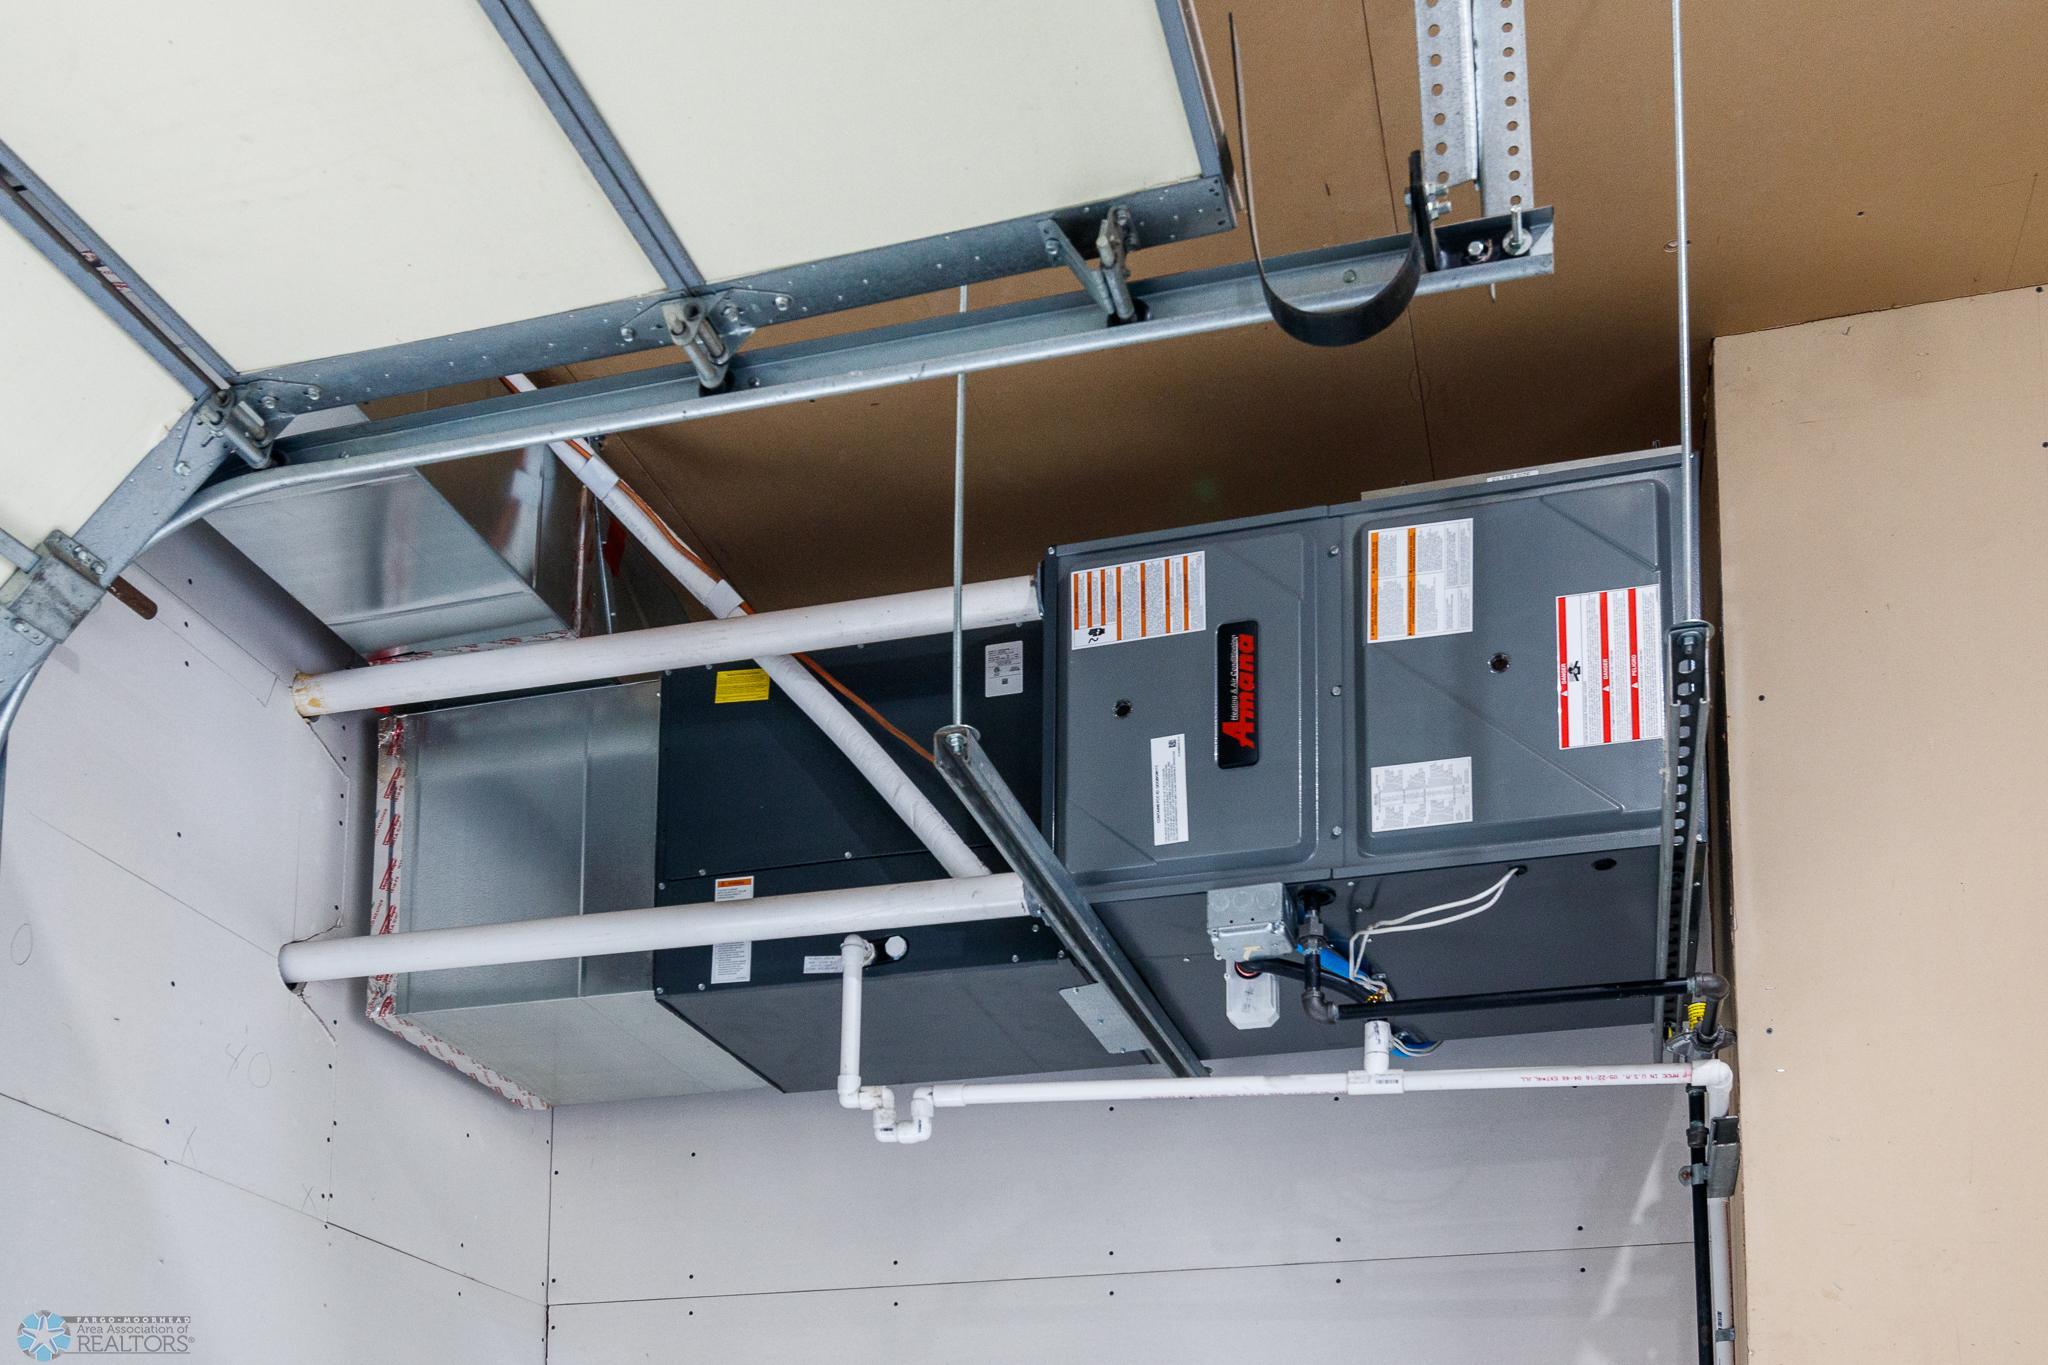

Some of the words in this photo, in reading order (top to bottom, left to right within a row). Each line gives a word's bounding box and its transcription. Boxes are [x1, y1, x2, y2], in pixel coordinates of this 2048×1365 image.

[1230, 634, 1239, 677] Conditioning
[1222, 633, 1256, 749] Amana
[1230, 678, 1238, 688] Air
[1230, 695, 1239, 721] Heating
